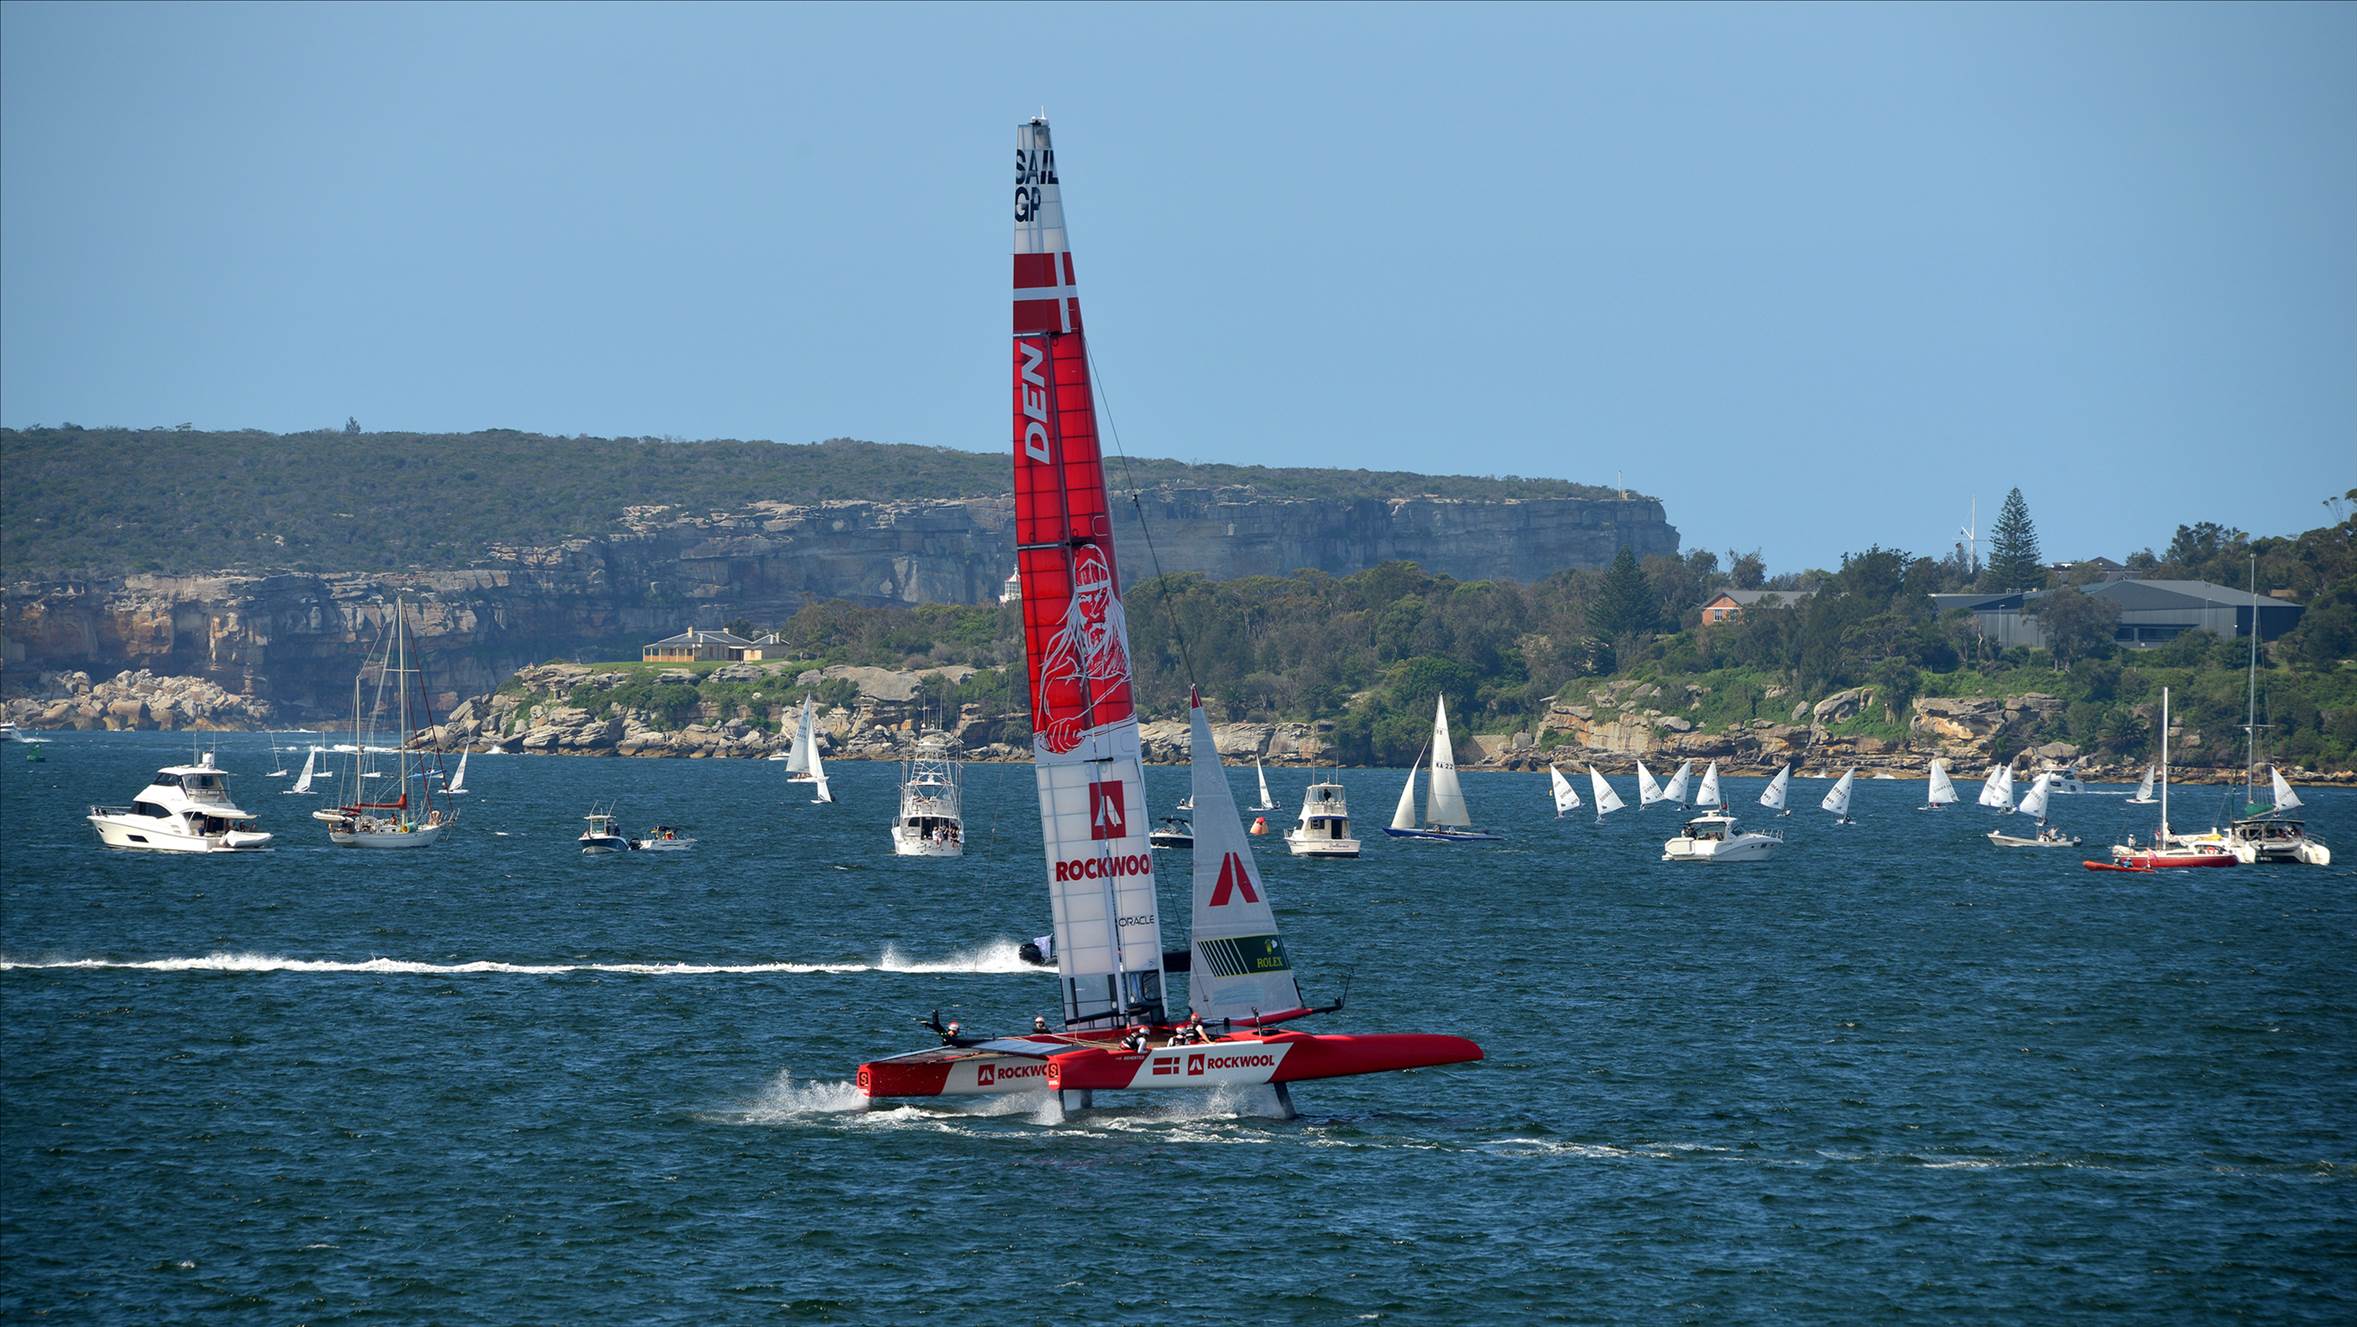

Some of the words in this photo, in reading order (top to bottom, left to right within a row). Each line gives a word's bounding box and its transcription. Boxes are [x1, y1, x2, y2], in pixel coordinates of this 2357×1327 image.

[1015, 149, 1059, 185] SAIL
[1015, 187, 1041, 223] GP
[1020, 342, 1050, 465] DEN
[1119, 915, 1154, 927] ORACLE
[1257, 957, 1283, 968] ROLEX
[1207, 1055, 1274, 1069] ROCKWOOL
